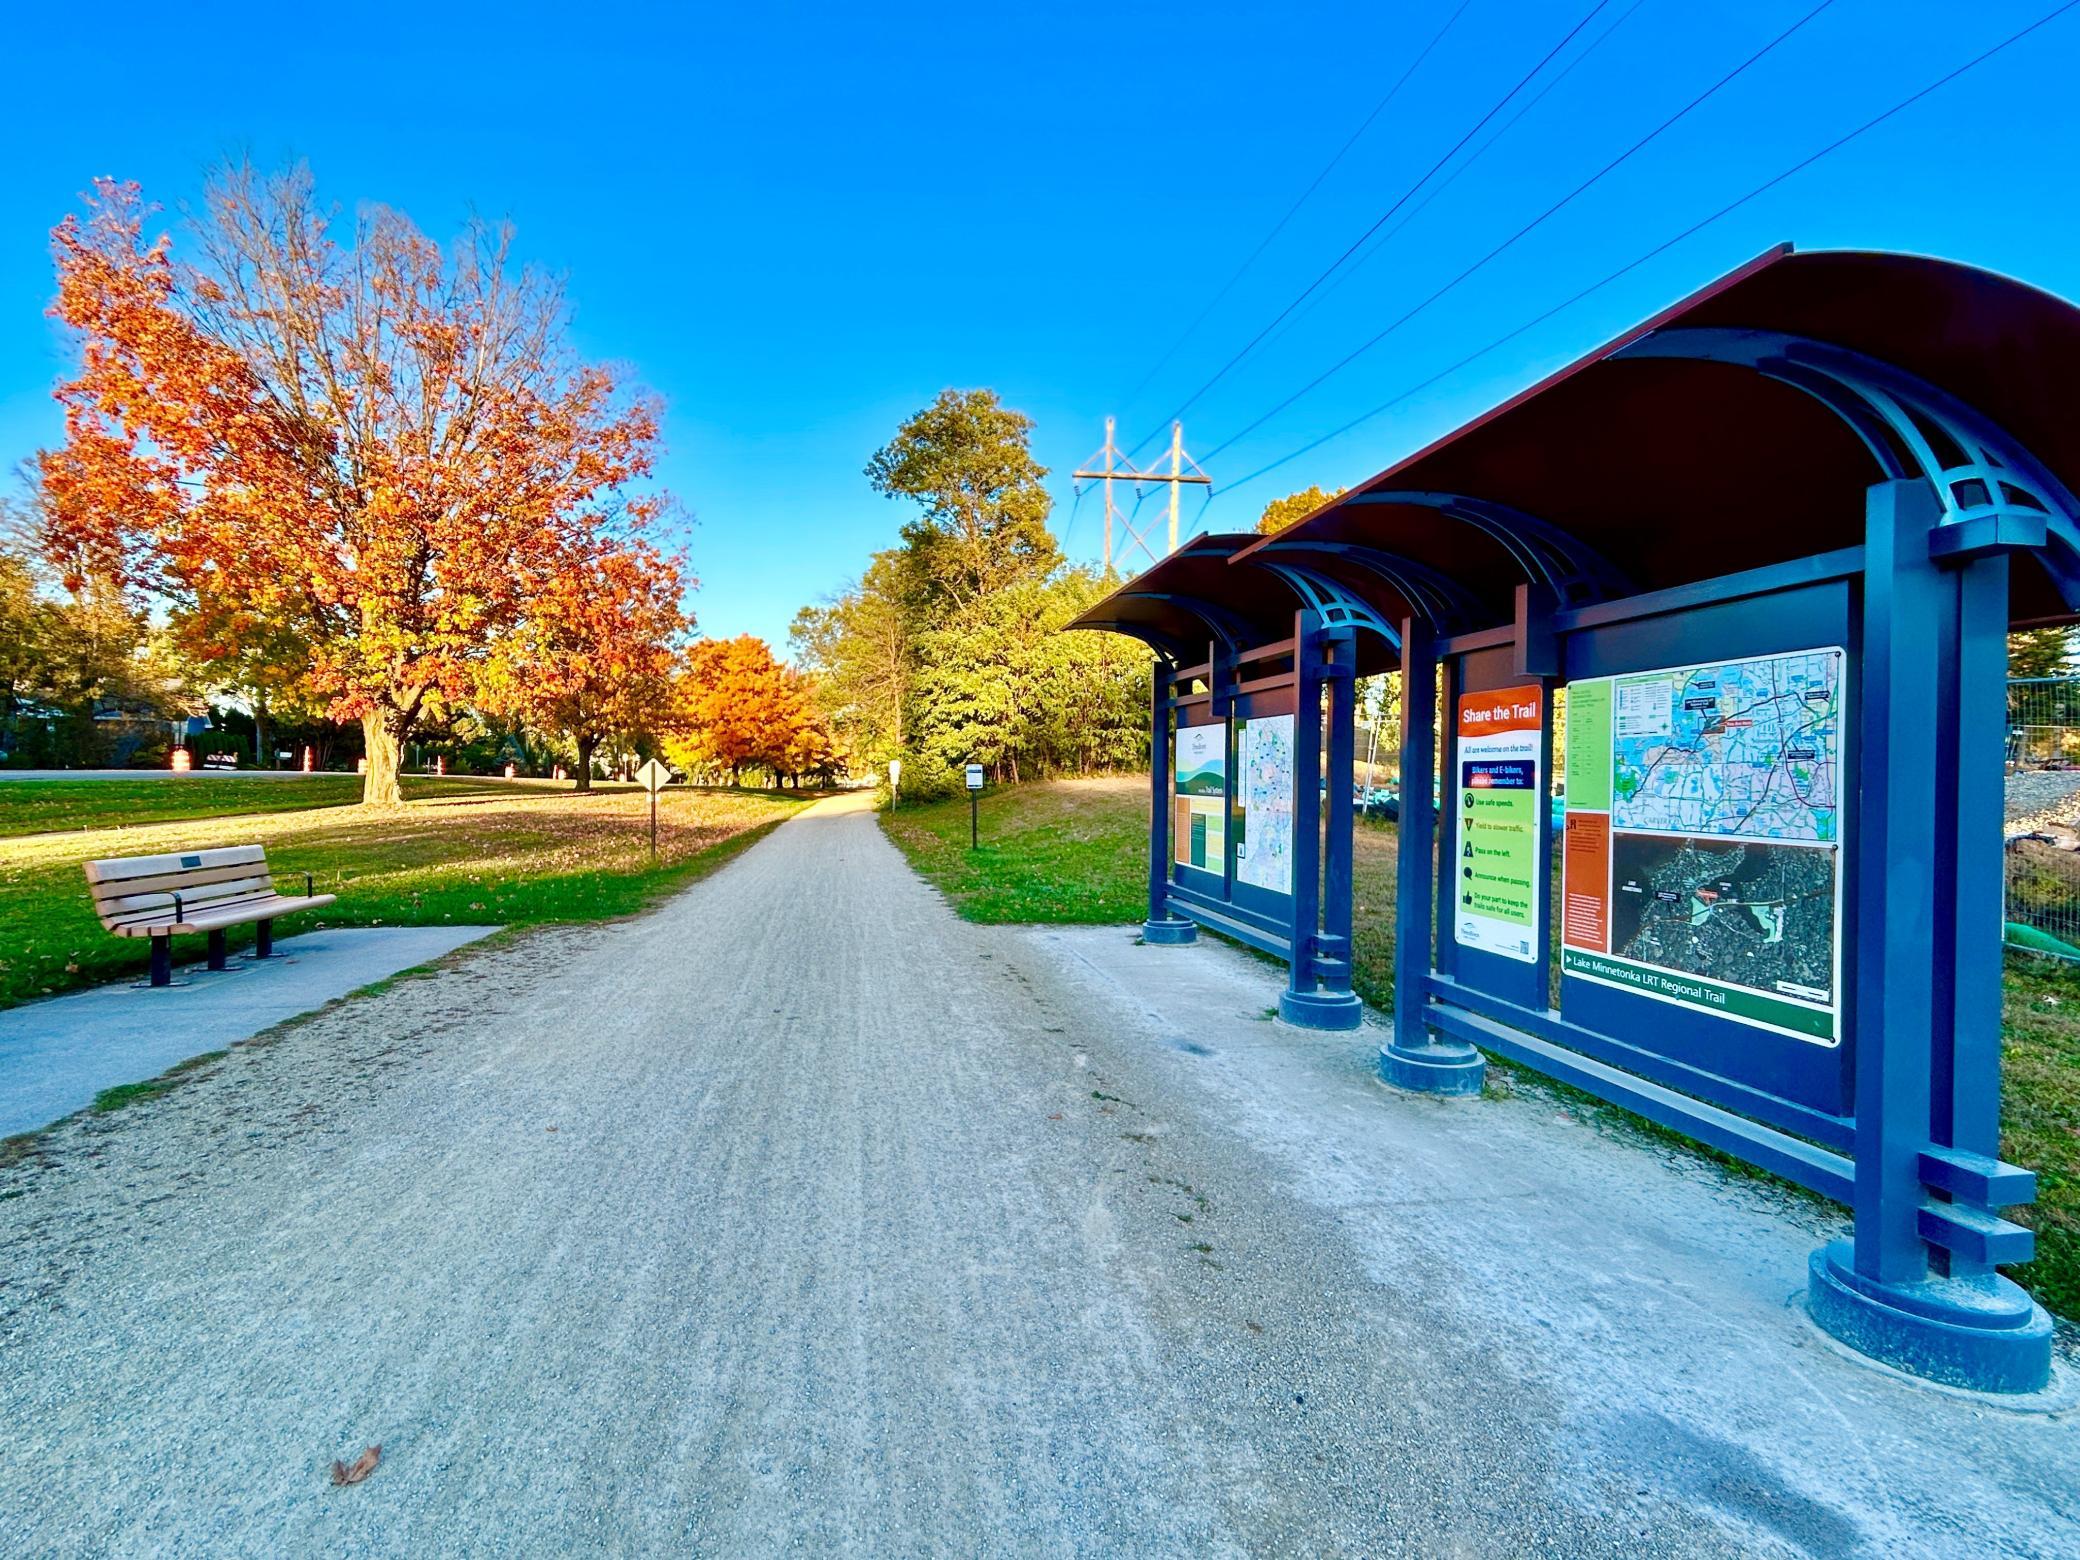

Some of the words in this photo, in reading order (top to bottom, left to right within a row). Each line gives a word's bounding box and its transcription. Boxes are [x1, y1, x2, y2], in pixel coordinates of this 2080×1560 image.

[1463, 708, 1491, 723] Share
[1493, 705, 1510, 721] the
[1512, 701, 1536, 719] Trail
[1480, 745, 1502, 753] welcome
[1510, 744, 1518, 752] the
[1472, 766, 1488, 774] Bikers
[1488, 766, 1498, 774] and
[1488, 777, 1515, 785] remember
[1573, 956, 1591, 969] Lake
[1592, 962, 1641, 983] Minnetonka
[1642, 973, 1659, 987] LRT
[1661, 978, 1702, 999] Regional
[1704, 988, 1725, 1004] Trail
